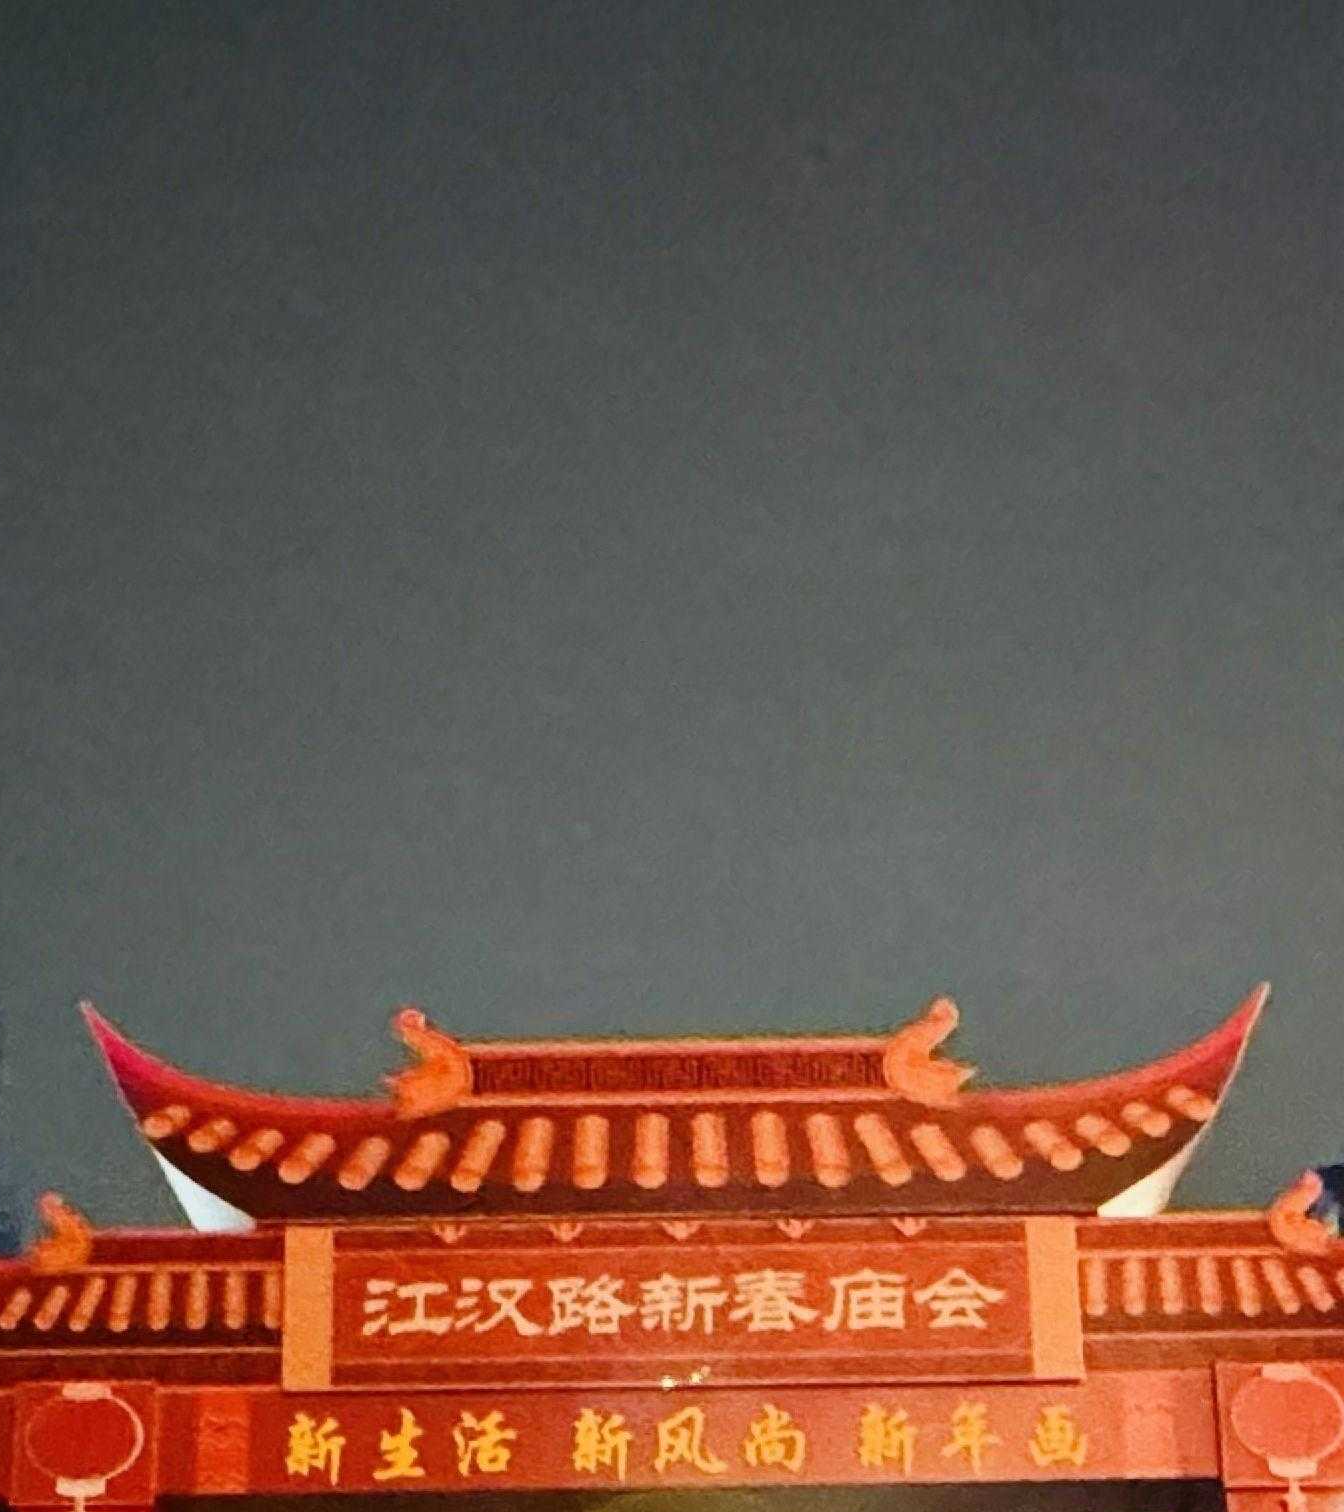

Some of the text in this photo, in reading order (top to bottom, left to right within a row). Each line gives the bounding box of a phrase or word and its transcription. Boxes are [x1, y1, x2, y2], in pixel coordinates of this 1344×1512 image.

[361, 1266, 1006, 1337] 江汉路新春庙会
[286, 1401, 1090, 1485] 新生活 新风尚 新年画
